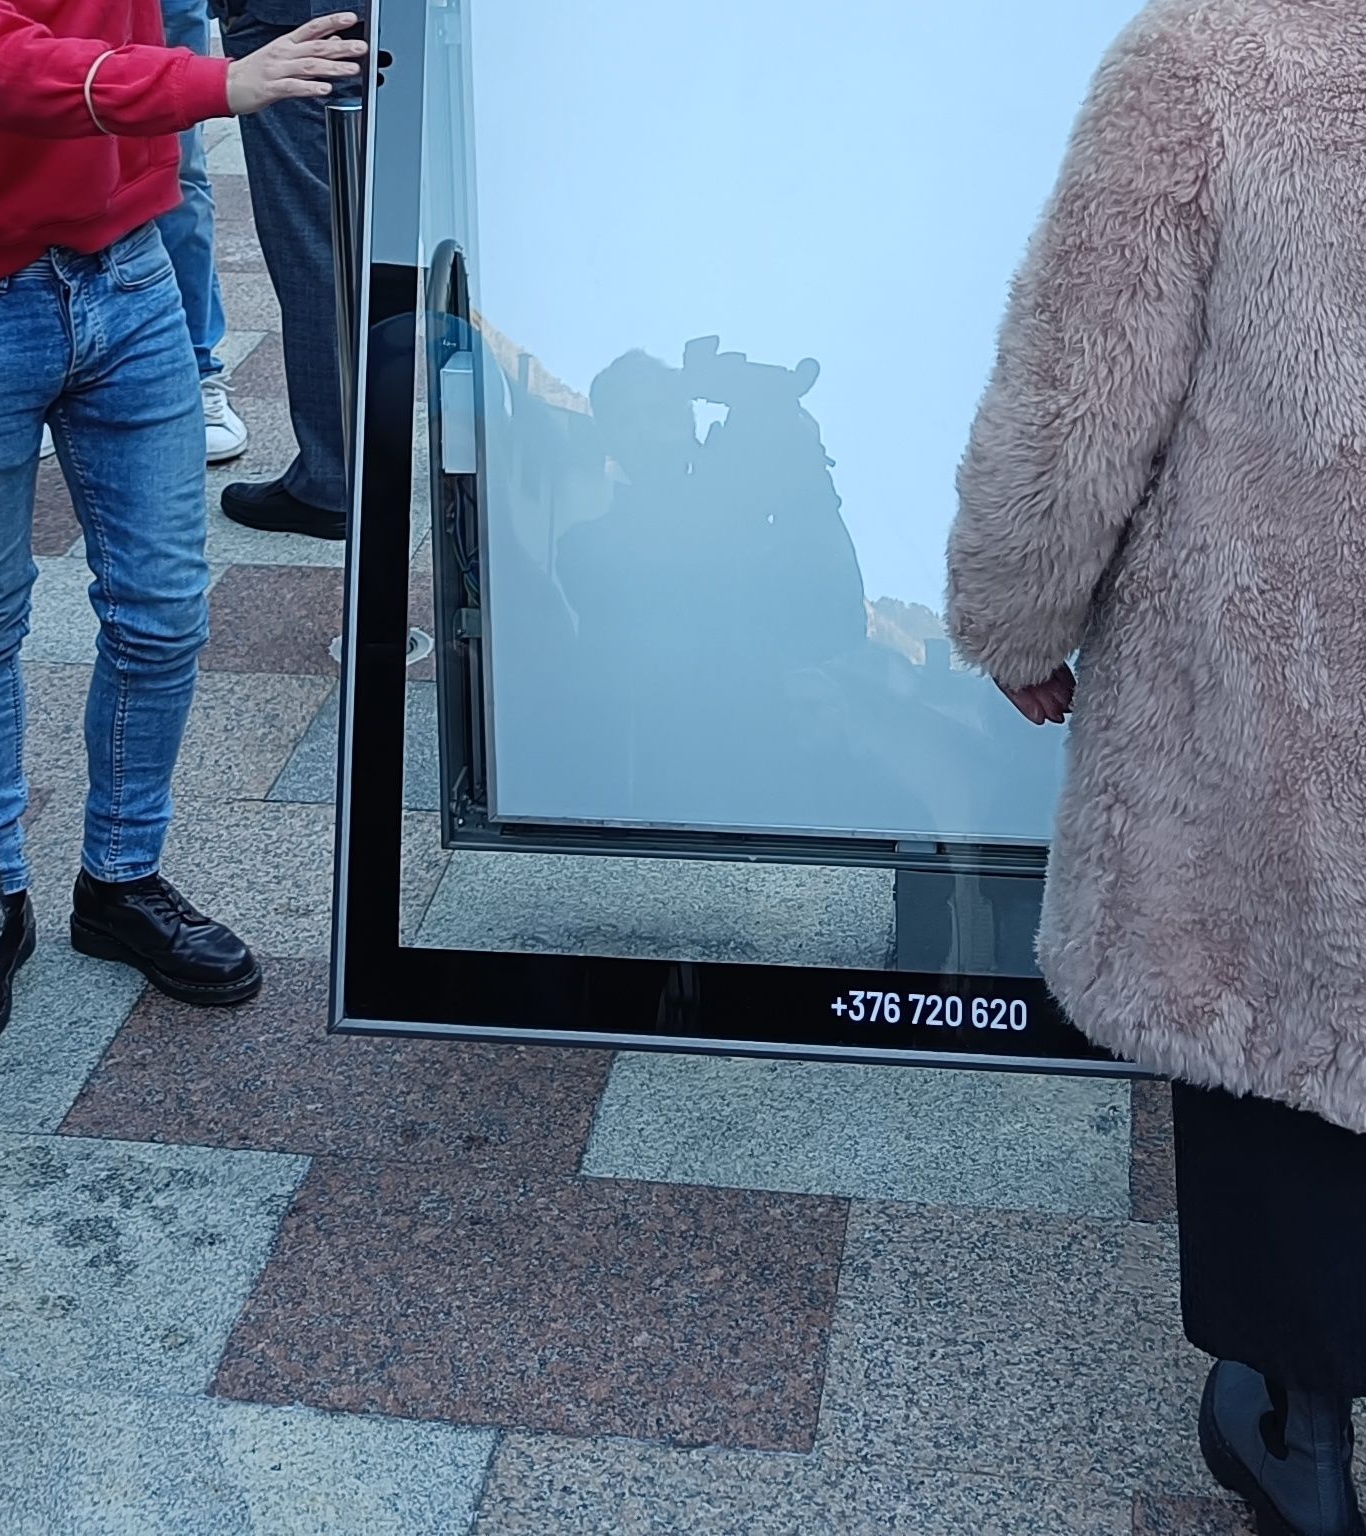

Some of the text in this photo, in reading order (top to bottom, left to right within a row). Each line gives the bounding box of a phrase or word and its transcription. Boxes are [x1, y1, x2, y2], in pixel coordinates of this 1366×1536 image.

[831, 990, 1028, 1031] +376 720 620
